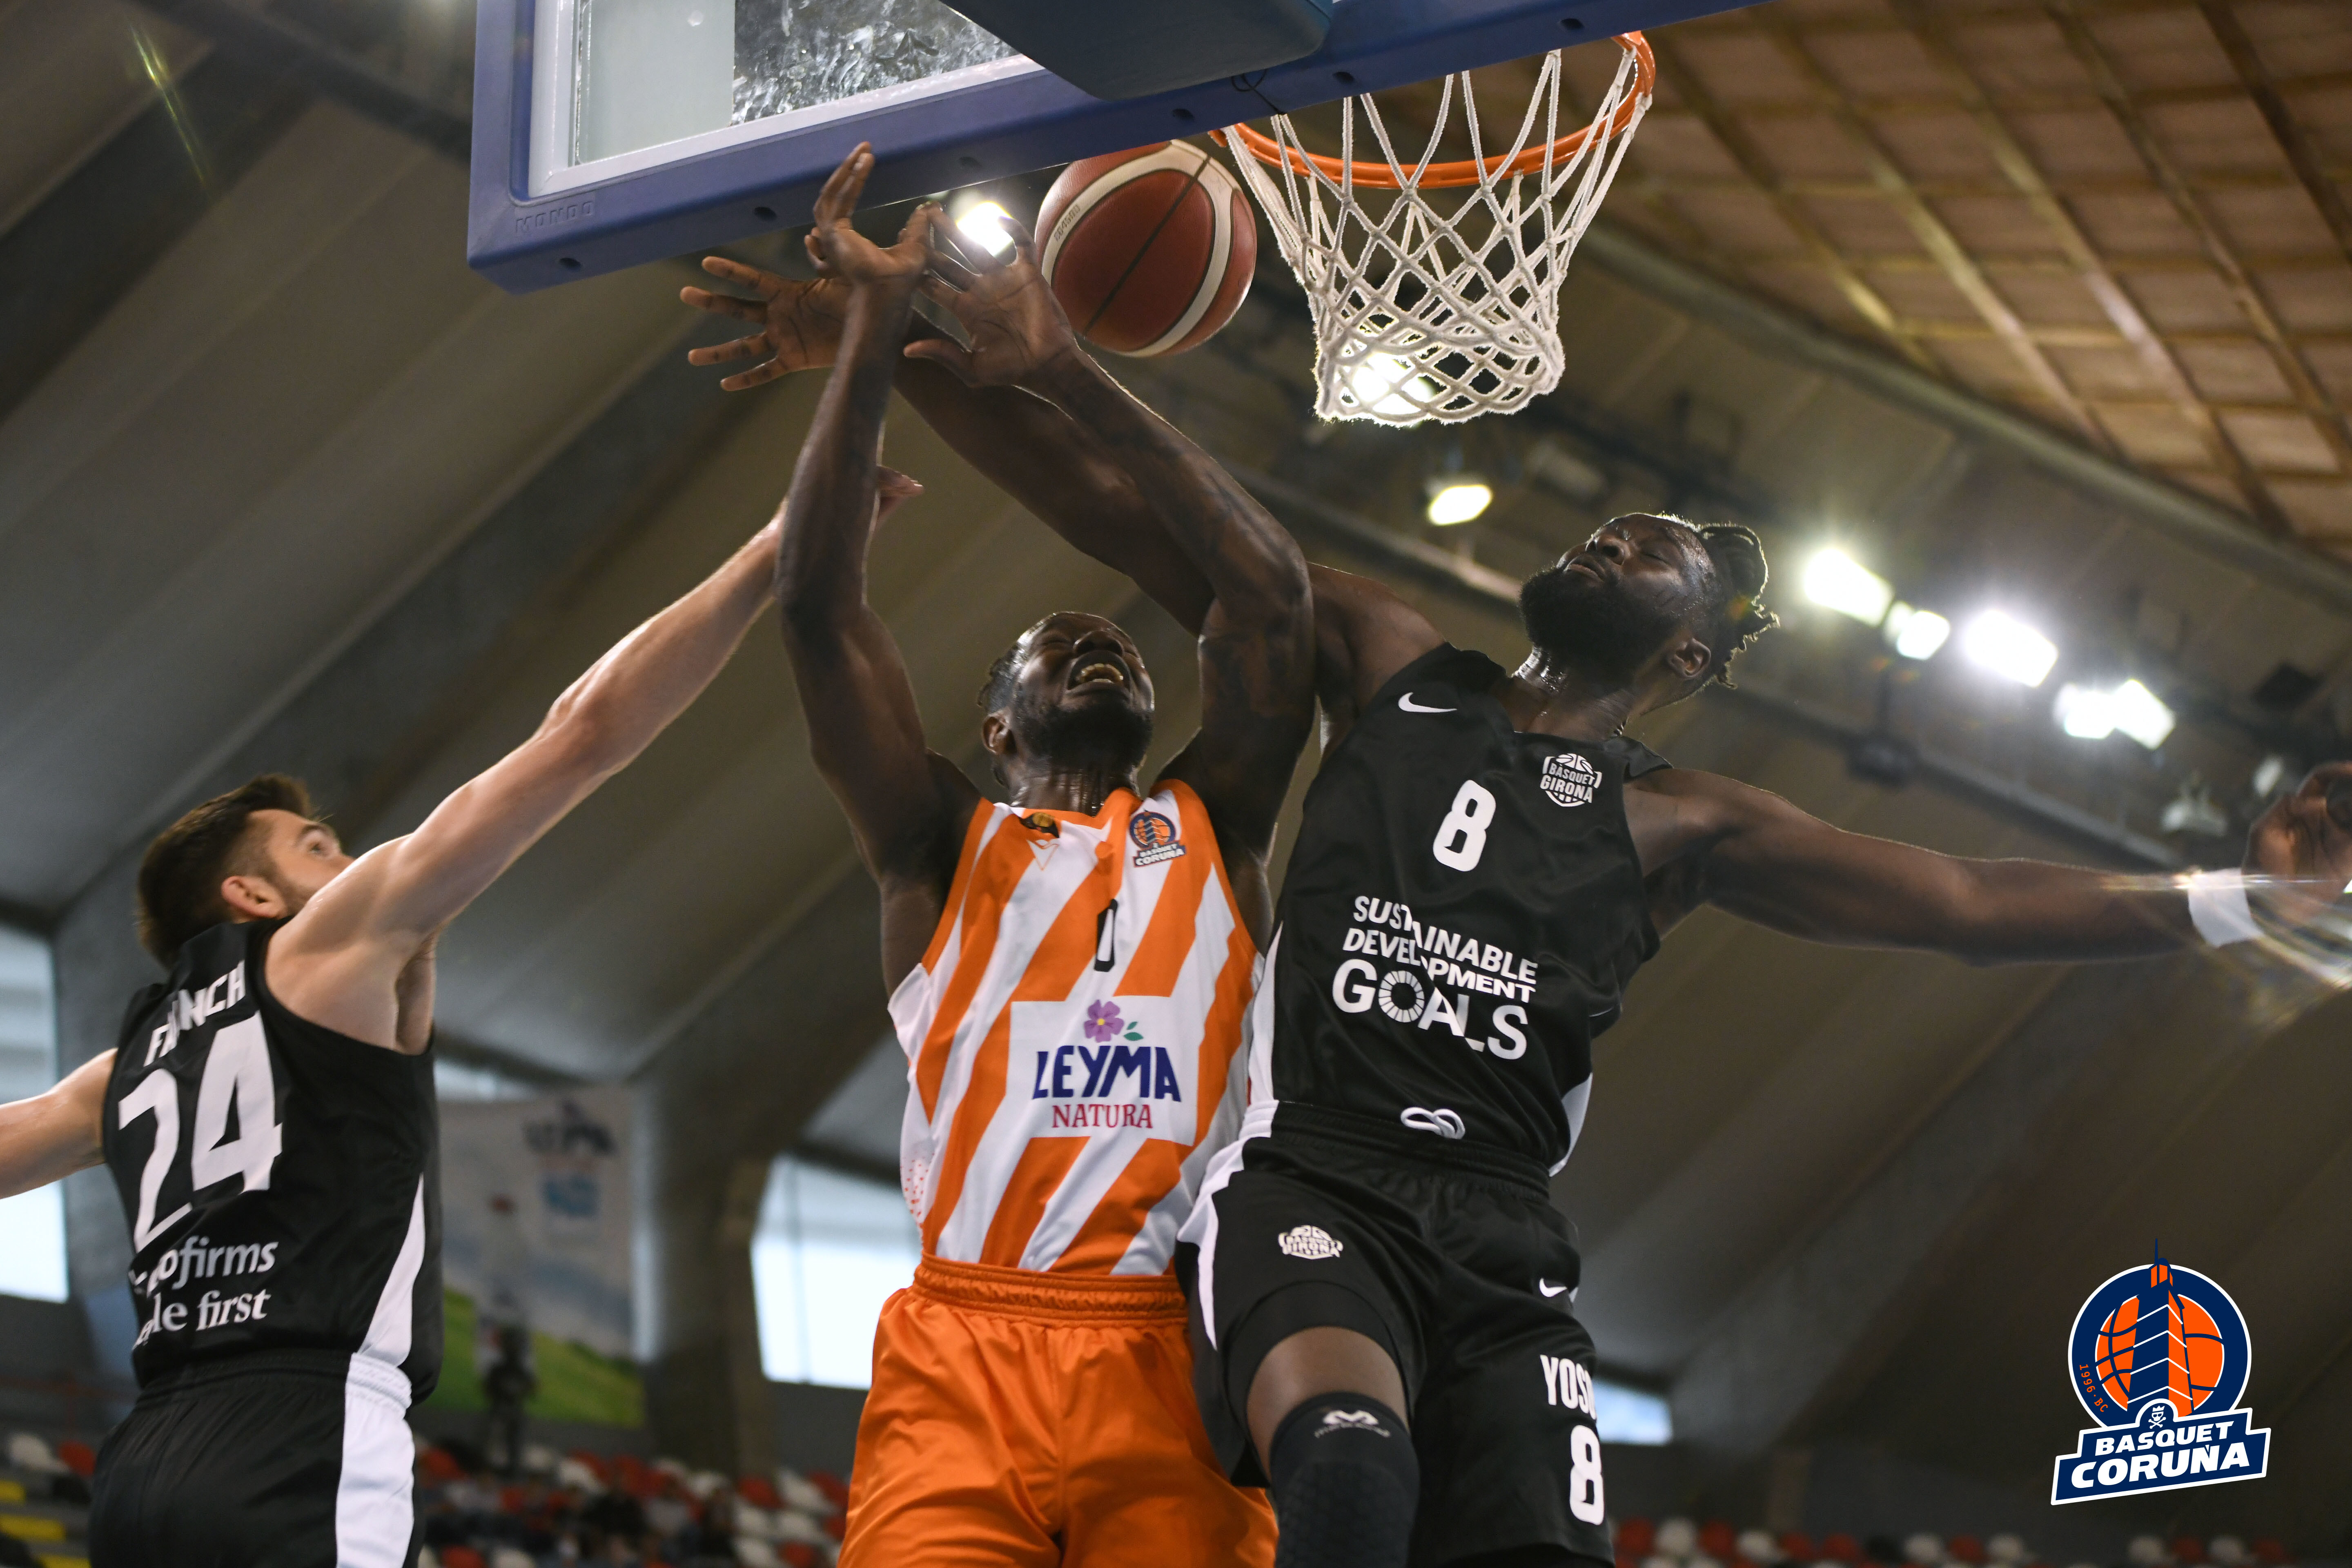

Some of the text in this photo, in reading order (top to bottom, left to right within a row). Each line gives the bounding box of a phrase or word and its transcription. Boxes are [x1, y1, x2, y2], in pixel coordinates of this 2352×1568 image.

[516, 201, 593, 234] MONDO
[1540, 775, 1593, 804] GIRONA
[1432, 780, 1497, 872] 8
[1332, 958, 1529, 1060] GOALS
[1031, 1045, 1181, 1102] LEYMA
[118, 1010, 282, 1253] 24
[1051, 1104, 1153, 1129] NATURA
[195, 1289, 272, 1332] first
[1569, 1425, 1605, 1526] 8
